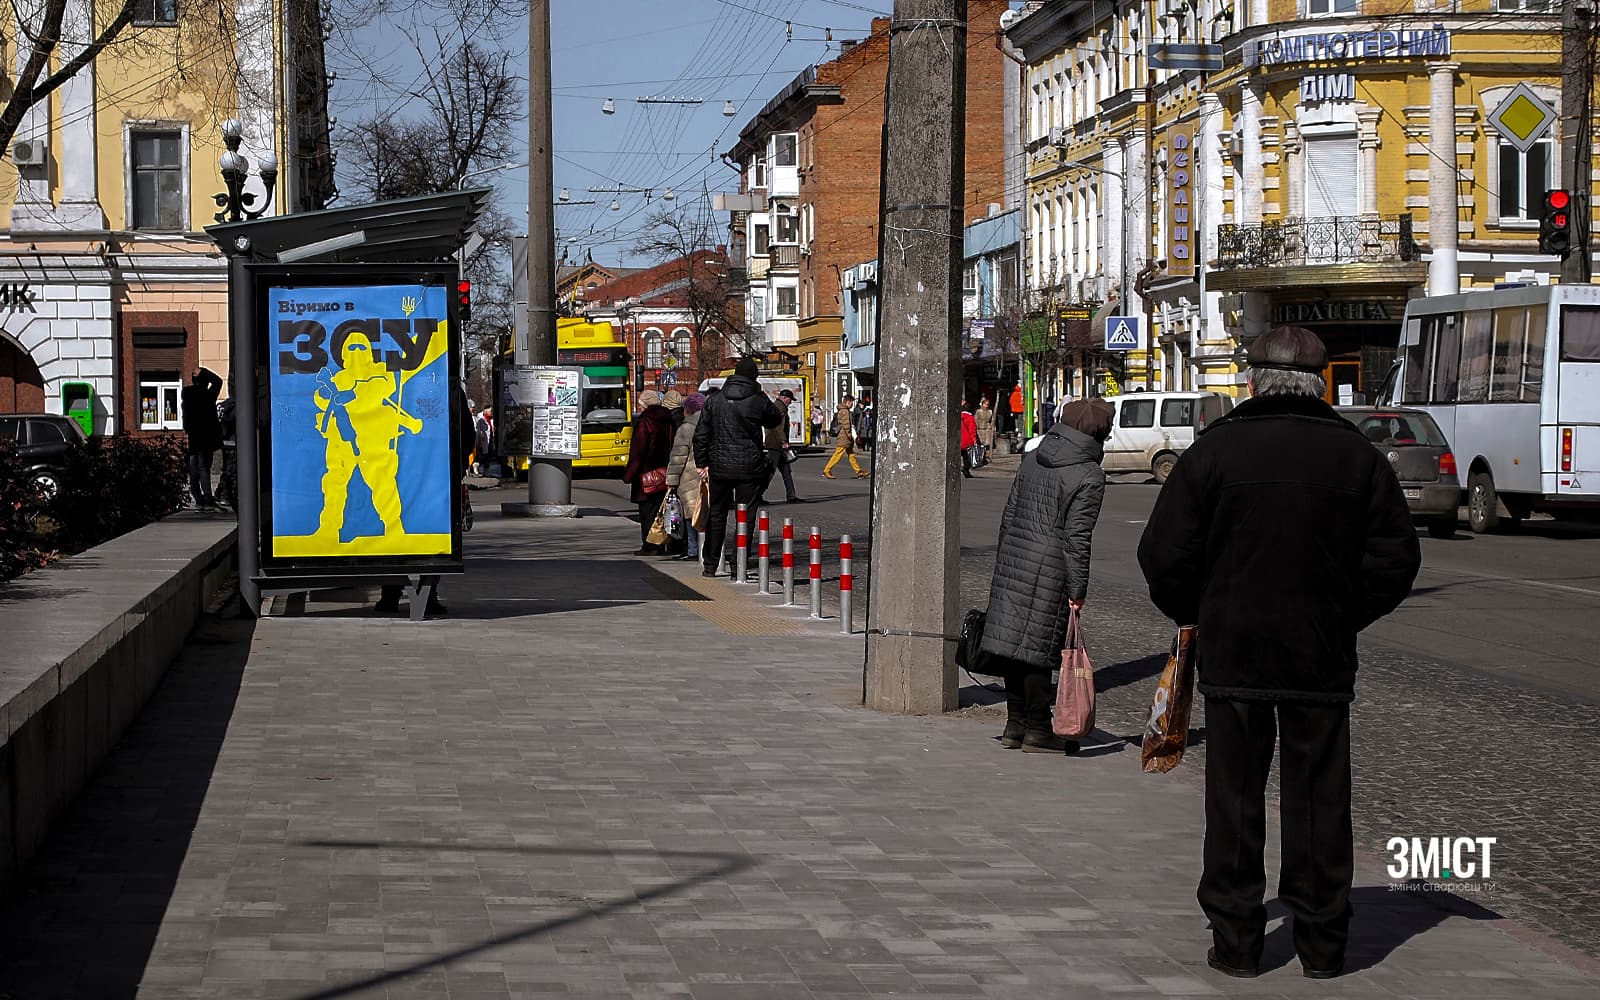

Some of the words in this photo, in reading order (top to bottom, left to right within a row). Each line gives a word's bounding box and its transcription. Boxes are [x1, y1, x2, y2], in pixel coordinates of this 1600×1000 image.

[1301, 75, 1353, 99] ДІМ
[278, 301, 339, 315] Віримо
[344, 302, 354, 311] в
[278, 319, 438, 374] ЗСУ
